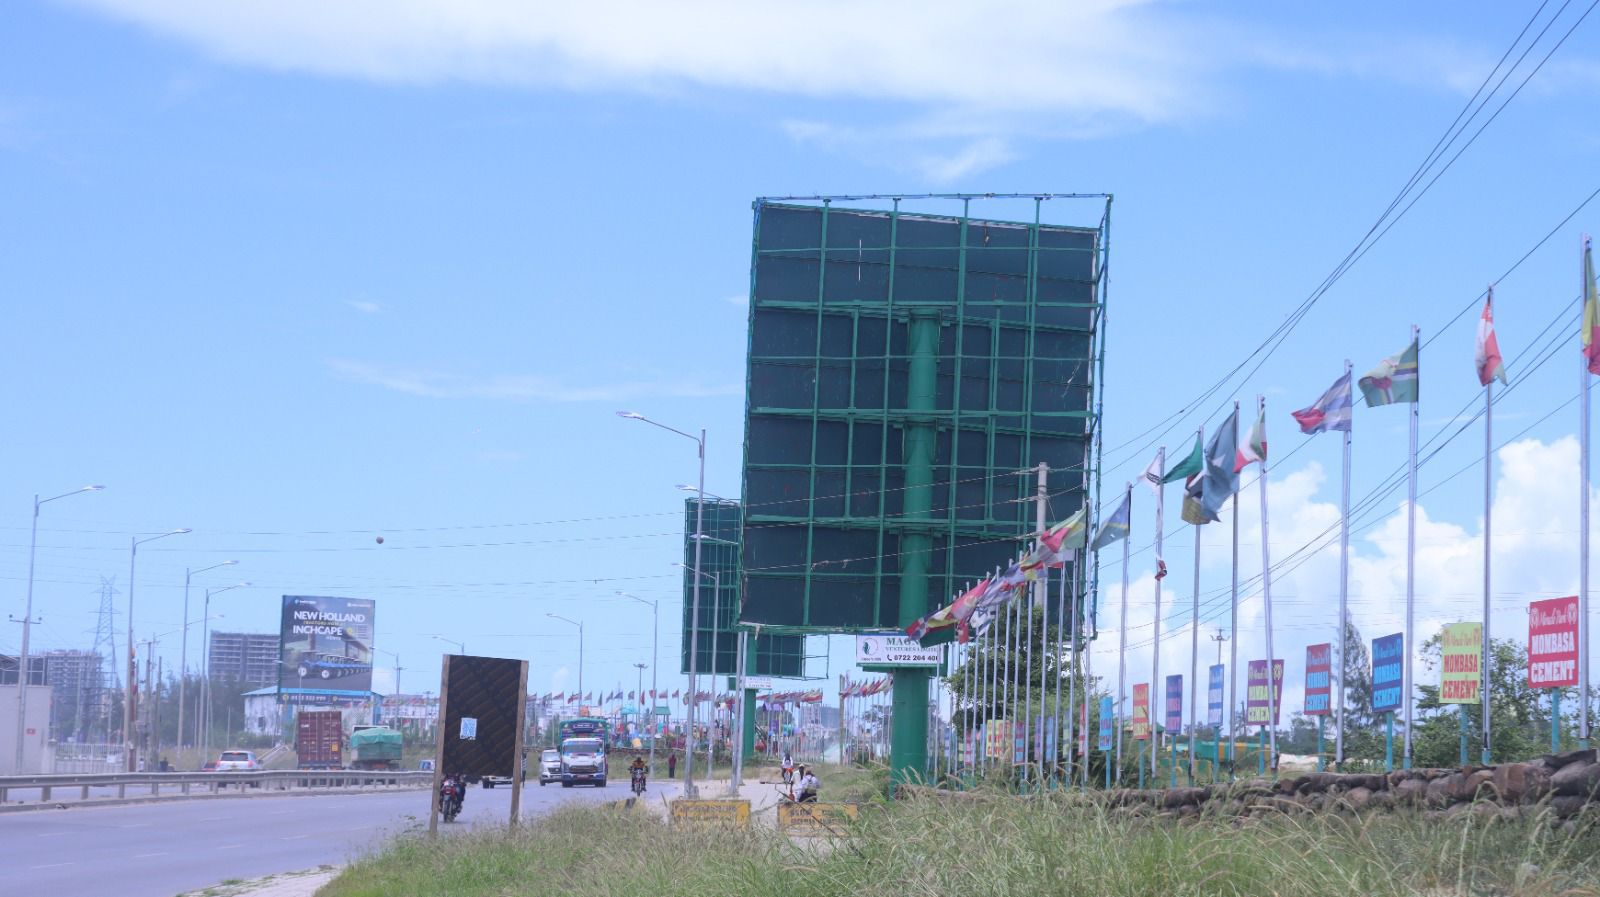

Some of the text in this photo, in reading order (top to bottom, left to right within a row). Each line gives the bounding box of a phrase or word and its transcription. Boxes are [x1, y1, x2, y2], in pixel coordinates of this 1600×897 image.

[294, 611, 365, 622] NEW HOLLAND
[293, 625, 343, 635] INCHCAPE
[1531, 631, 1575, 655] MOMBASA
[1444, 654, 1478, 673] MOMBASA
[1531, 659, 1575, 683] CEMENT
[1442, 680, 1478, 699] CEMENT
